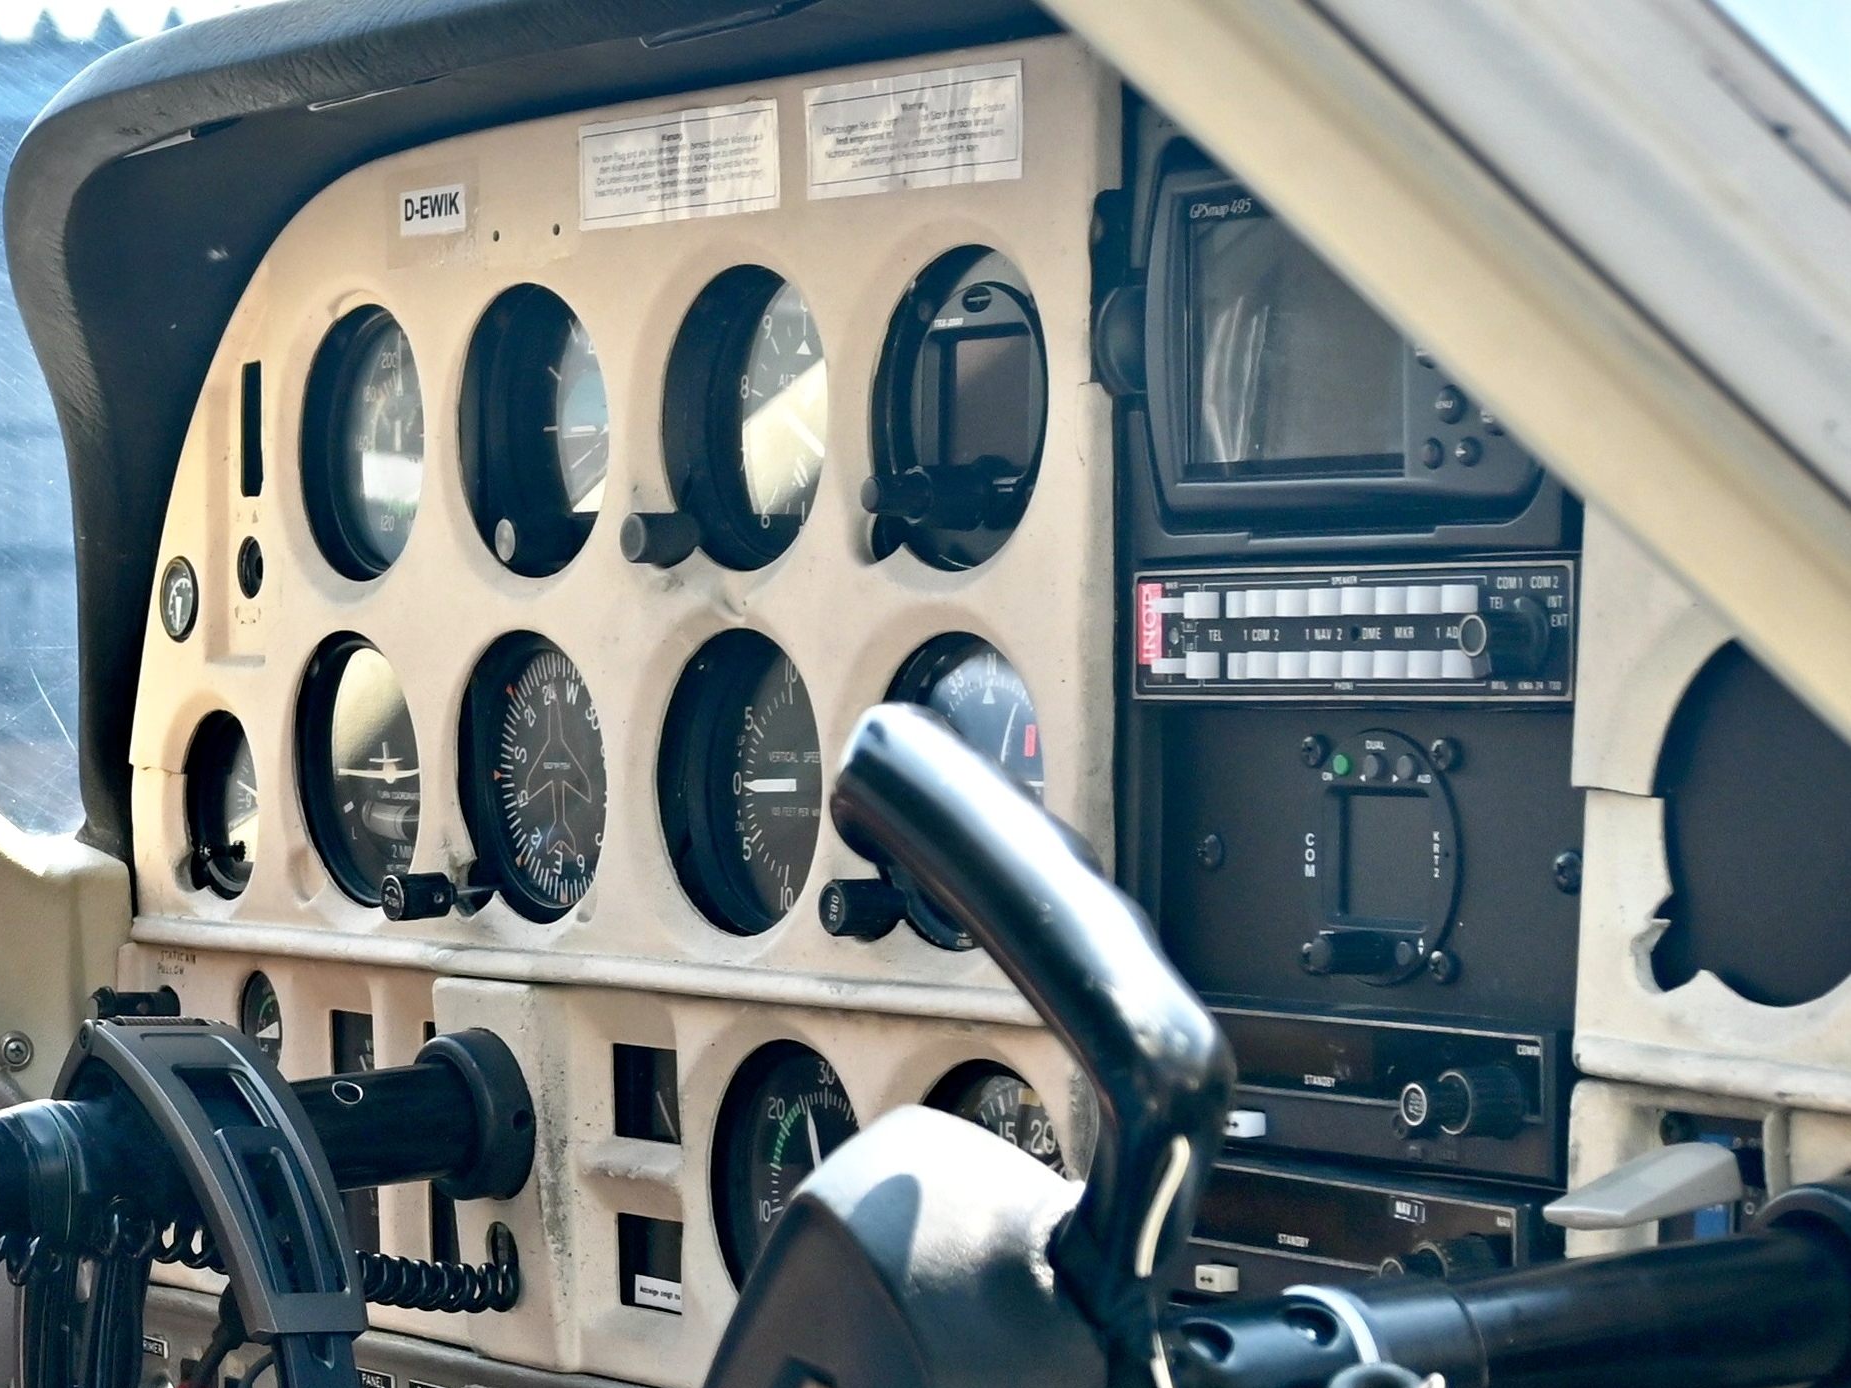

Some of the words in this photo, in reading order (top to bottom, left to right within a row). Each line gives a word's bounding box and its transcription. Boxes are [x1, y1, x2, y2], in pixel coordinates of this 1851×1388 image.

[404, 191, 460, 222] D-EWIK
[1190, 202, 1230, 219] GPSmap
[1230, 198, 1252, 215] 495
[762, 314, 773, 339] 9
[381, 351, 398, 369] 200
[740, 374, 749, 400] 8
[380, 513, 395, 532] 120
[1497, 576, 1517, 589] COM
[1530, 576, 1551, 589] COM
[1553, 575, 1559, 589] 2
[1551, 613, 1568, 627] EXT
[1208, 629, 1222, 642] TEL
[1243, 629, 1248, 641] 1
[1252, 629, 1270, 642] COM
[1274, 629, 1280, 642] 2
[1306, 628, 1310, 641] 1
[1314, 628, 1331, 641] NAV
[1336, 628, 1343, 641] 2
[1362, 627, 1381, 640] DME
[1395, 626, 1414, 639] MKR
[1446, 626, 1459, 638] AD
[785, 657, 798, 684] 10
[987, 653, 997, 676] N
[542, 685, 557, 706] 24
[566, 680, 579, 706] W
[524, 705, 537, 727] 21
[745, 706, 754, 731] 5
[514, 745, 527, 764] S
[1365, 740, 1386, 751] DUAL
[768, 751, 798, 763] VERTICAL
[803, 751, 821, 763] SPEE
[732, 772, 743, 796] 0
[1321, 772, 1334, 781] ON
[516, 789, 529, 808] 15
[782, 806, 797, 817] FEET
[391, 844, 398, 859] 2
[742, 837, 752, 861] 5
[1304, 832, 1316, 878] COM
[553, 850, 564, 875] E
[780, 886, 794, 912] 10
[829, 894, 840, 922] OBS
[818, 1060, 836, 1086] 30
[1304, 1074, 1336, 1088] STANDBY
[767, 1096, 786, 1121] 20
[759, 1199, 771, 1223] 10
[1396, 1200, 1411, 1216] NAV
[1278, 1233, 1310, 1248] STANDBY
[142, 1339, 163, 1355] RIMER
